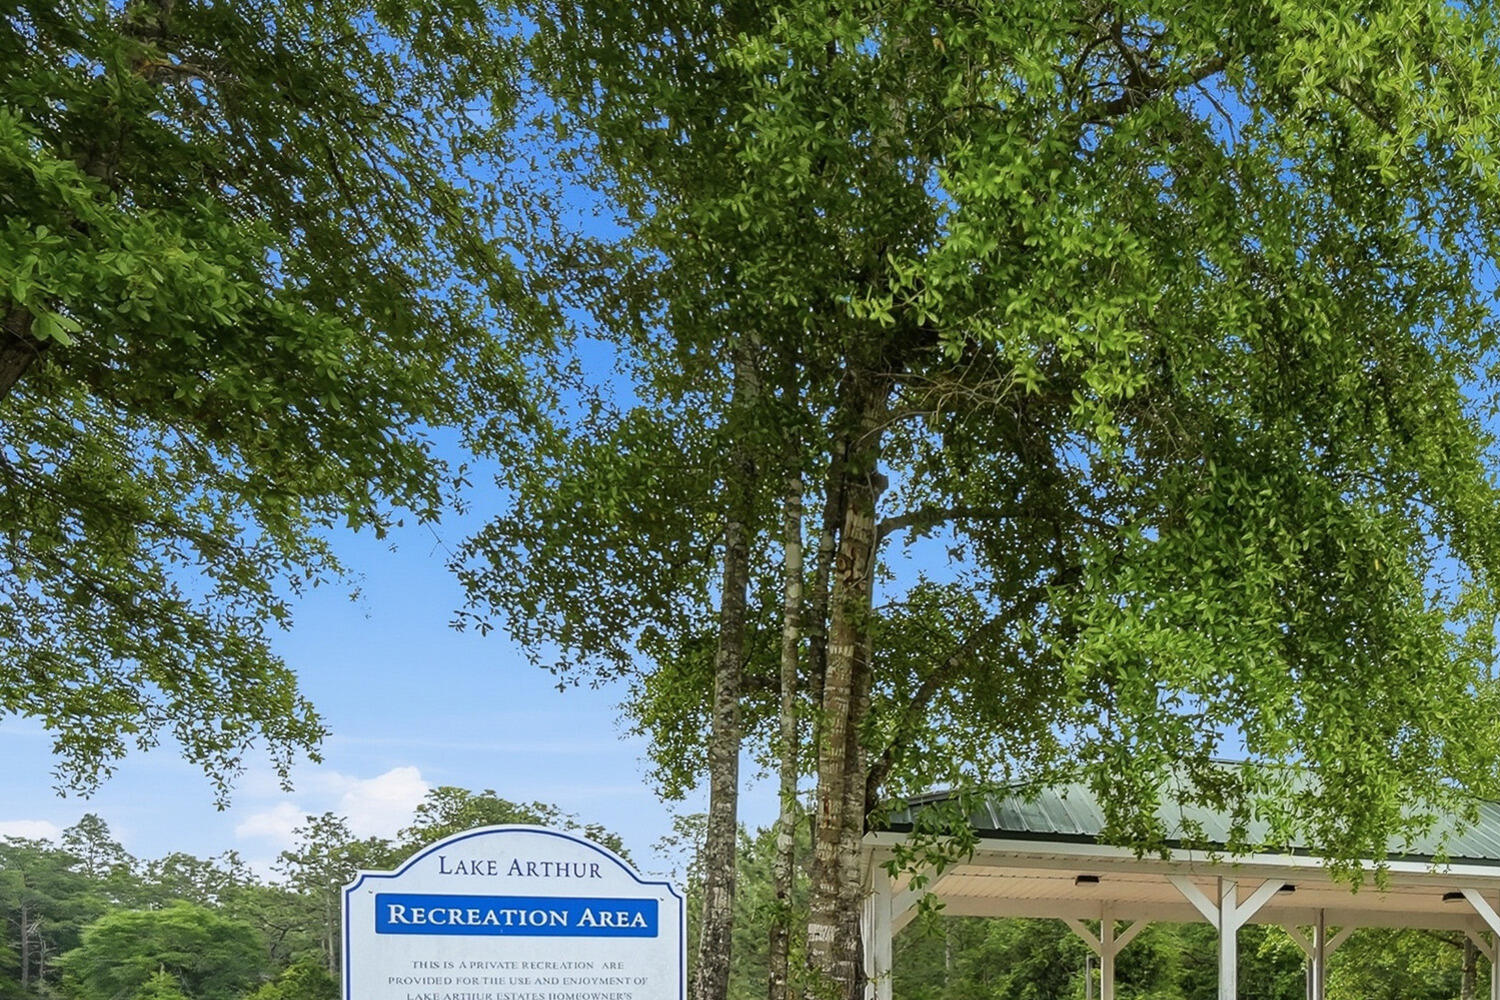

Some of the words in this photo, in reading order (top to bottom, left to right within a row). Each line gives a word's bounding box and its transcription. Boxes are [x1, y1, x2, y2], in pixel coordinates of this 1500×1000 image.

[438, 854, 499, 877] LAKE
[506, 857, 603, 880] ARTHUR
[387, 904, 569, 927] RECREATION
[575, 907, 648, 928] AREA
[411, 960, 441, 970] THIS
[443, 960, 455, 970] IS
[458, 960, 468, 970] A
[469, 960, 519, 971] PRIVATE
[521, 961, 595, 971] RECREATION
[601, 961, 625, 971] ARE
[388, 976, 453, 986] PROVIDED
[455, 976, 481, 986] FOR
[481, 976, 507, 986] THE
[508, 976, 532, 986] USE
[534, 976, 560, 986] AND
[562, 976, 632, 986] ENJOYMENT
[633, 976, 649, 986] OF
[442, 992, 493, 1000] ARTHUR
[496, 992, 546, 1000] ESTATES
[548, 991, 633, 1000] HOMEOWNER'S
